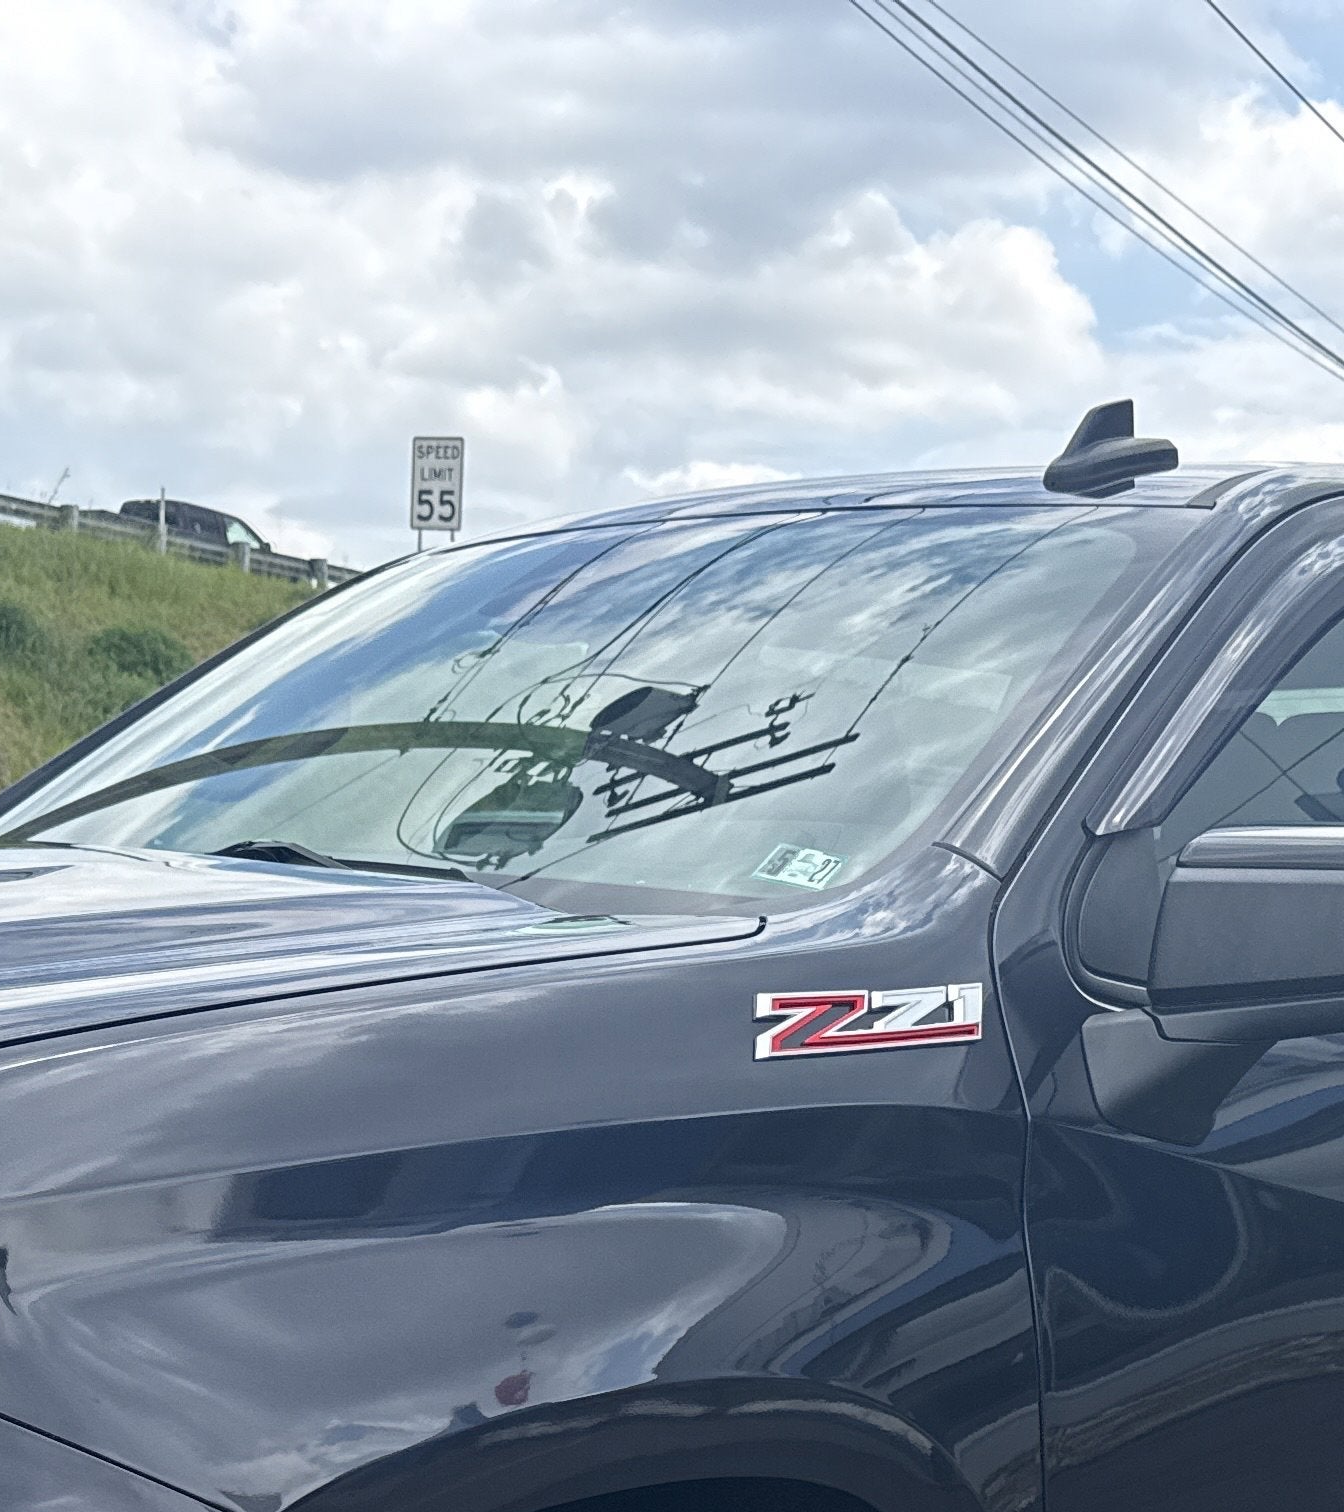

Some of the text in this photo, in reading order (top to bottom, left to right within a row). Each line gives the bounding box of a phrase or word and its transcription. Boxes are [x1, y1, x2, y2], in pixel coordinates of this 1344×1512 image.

[417, 445, 460, 460] SPEED
[419, 467, 454, 481] LIMIT
[416, 489, 456, 522] 55
[807, 858, 841, 884] 27
[754, 982, 983, 1060] Z71
